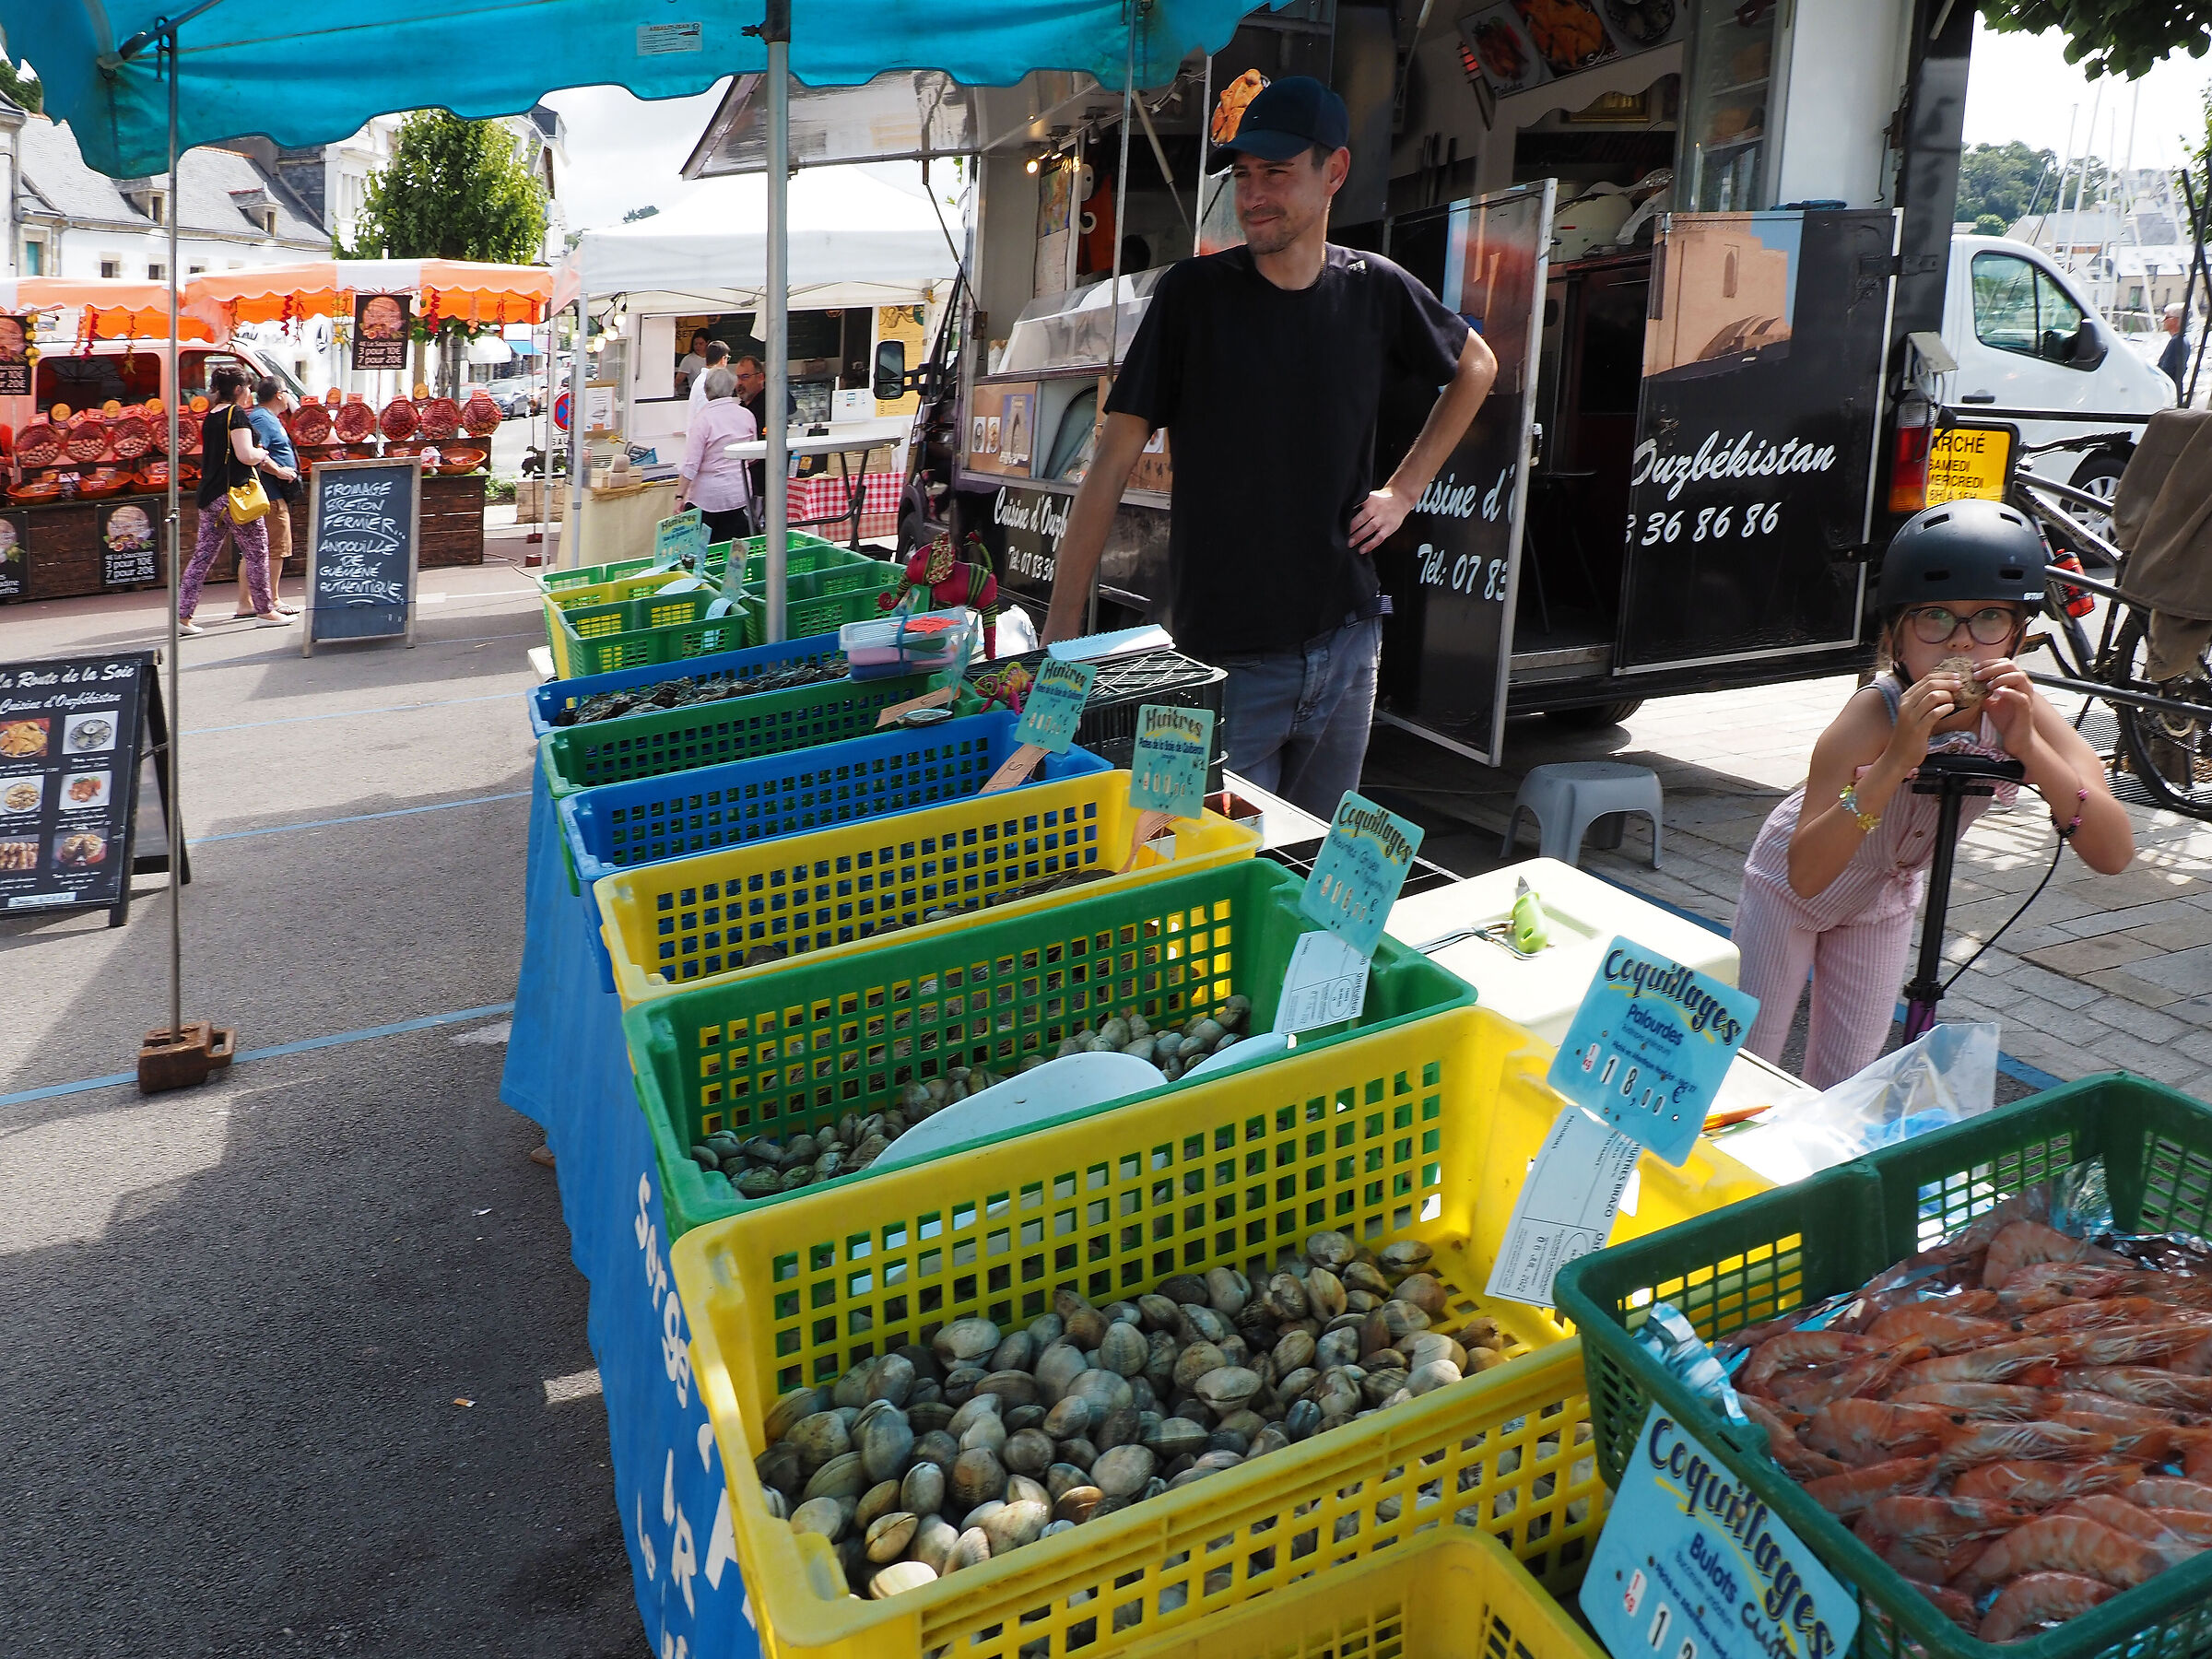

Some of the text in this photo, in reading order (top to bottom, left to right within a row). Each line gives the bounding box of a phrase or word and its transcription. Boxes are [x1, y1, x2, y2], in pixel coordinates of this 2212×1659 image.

[358, 347, 365, 355] 3
[364, 348, 386, 357] pour
[364, 357, 386, 365] pour
[552, 437, 569, 446] SAU
[1932, 432, 1986, 453] ARCHÉ
[1928, 458, 1971, 473] SAMEDI
[324, 481, 393, 498] FROMAGE
[1931, 474, 1984, 488] ERCREDI
[324, 498, 385, 512] BRETON
[1411, 473, 1477, 519] isine
[994, 486, 1030, 530] Cuisine
[1641, 510, 1686, 546] 36
[1692, 506, 1735, 542] 86
[1741, 501, 1783, 538] 86
[318, 538, 400, 556] ANDOUILLE
[105, 560, 112, 570] 3
[112, 559, 135, 571] pour
[339, 554, 365, 567] DE
[1020, 552, 1032, 575] 07
[1031, 554, 1044, 579] 83
[105, 570, 113, 579] 7
[113, 569, 136, 580] pour
[1452, 554, 1482, 594] 07
[16, 671, 60, 688] Route
[61, 667, 80, 683] de
[82, 666, 99, 682] la
[100, 664, 135, 680] Soie
[1604, 948, 1744, 1045] Coquillages
[1626, 1004, 1685, 1046] Palourdes
[1648, 1418, 1836, 1659] Coquillages
[1689, 1532, 1738, 1604] Bulots
